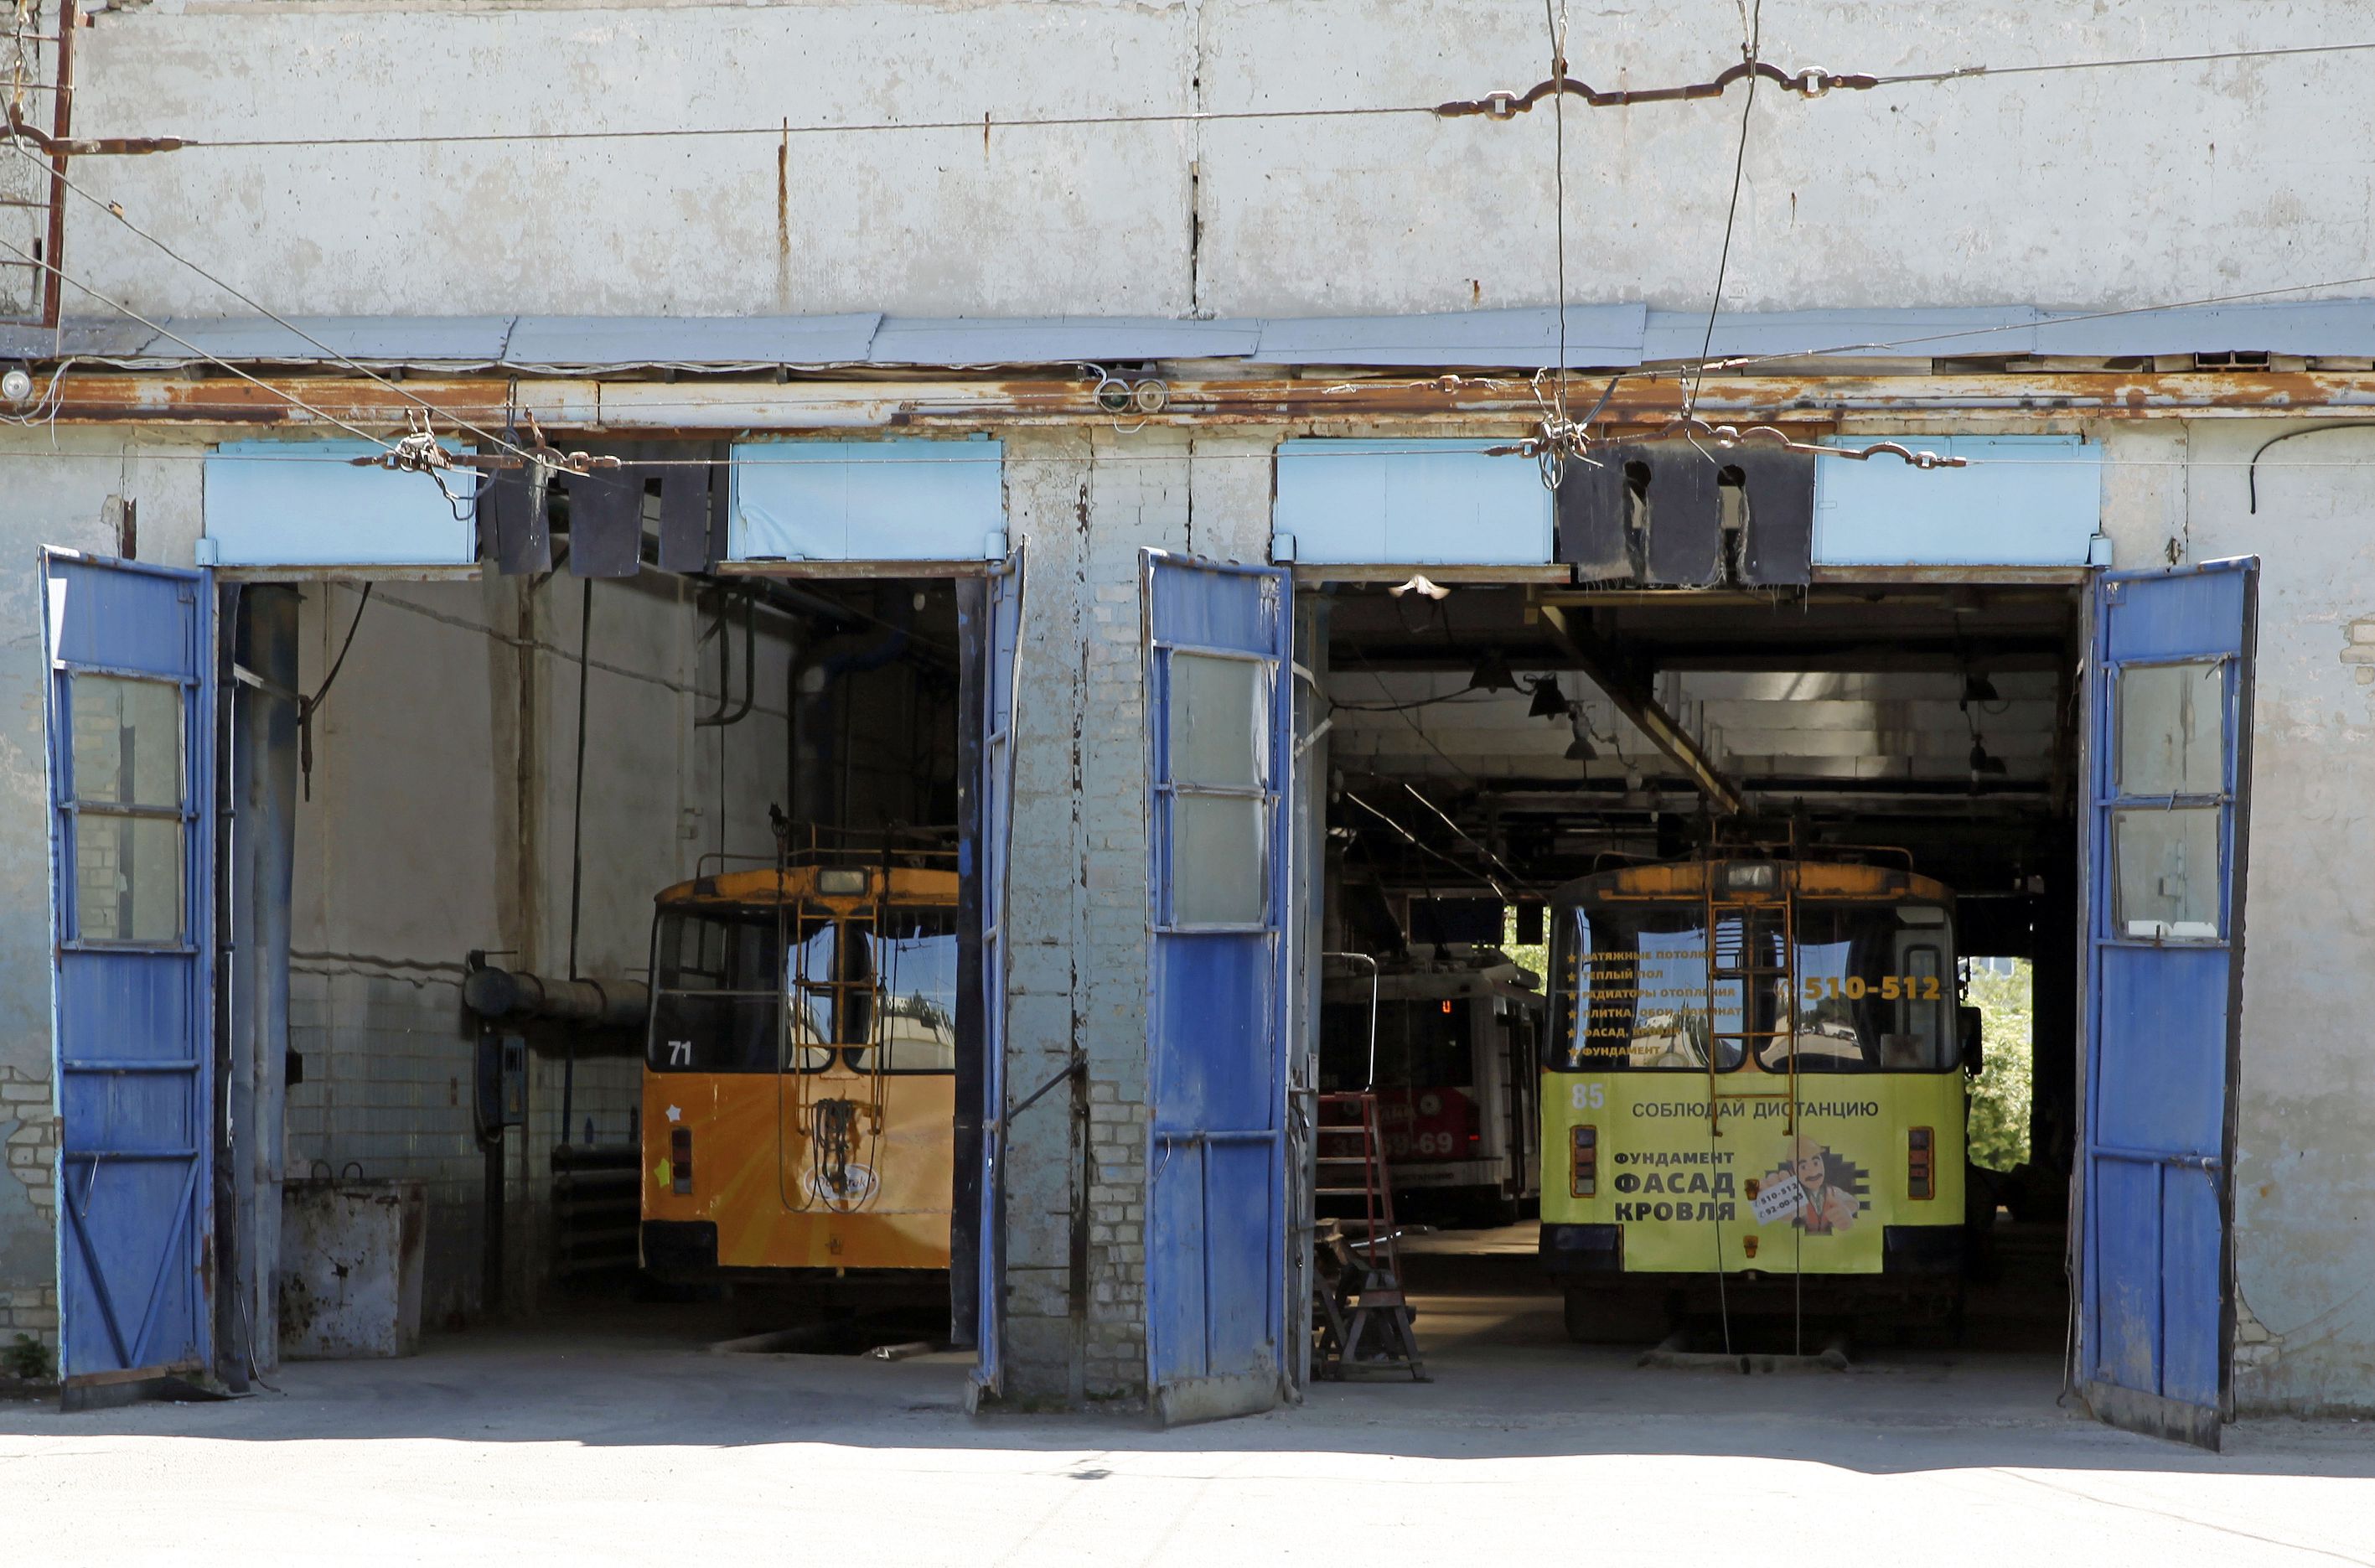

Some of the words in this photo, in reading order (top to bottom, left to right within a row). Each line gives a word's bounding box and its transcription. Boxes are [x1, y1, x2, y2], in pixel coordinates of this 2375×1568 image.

[1581, 950, 1652, 961] НАТЯЖНЫЕ
[1582, 968, 1632, 980] ТЕПЛЫЙ
[1637, 970, 1664, 979] ПОЛ
[1581, 989, 1656, 1001] РАДИАТОРЫ
[1804, 975, 1941, 1000] 510-512
[1582, 1008, 1635, 1019] ПЛИТКА,
[1582, 1027, 1629, 1038] ФАСАД,
[668, 1040, 691, 1065] 71
[1582, 1046, 1660, 1058] ФУНДАМЕНТ
[1571, 1083, 1604, 1110] 85
[1632, 1098, 1745, 1120] СОБЛЮДАЙ
[1753, 1101, 1879, 1120] ДИСТАНЦИЮ
[1614, 1152, 1735, 1167] ФУНДАМЕНТ
[1614, 1172, 1736, 1199] ФАСАД
[1761, 1182, 1798, 1204] 510-512
[1614, 1202, 1736, 1222] КРОВЛЯ
